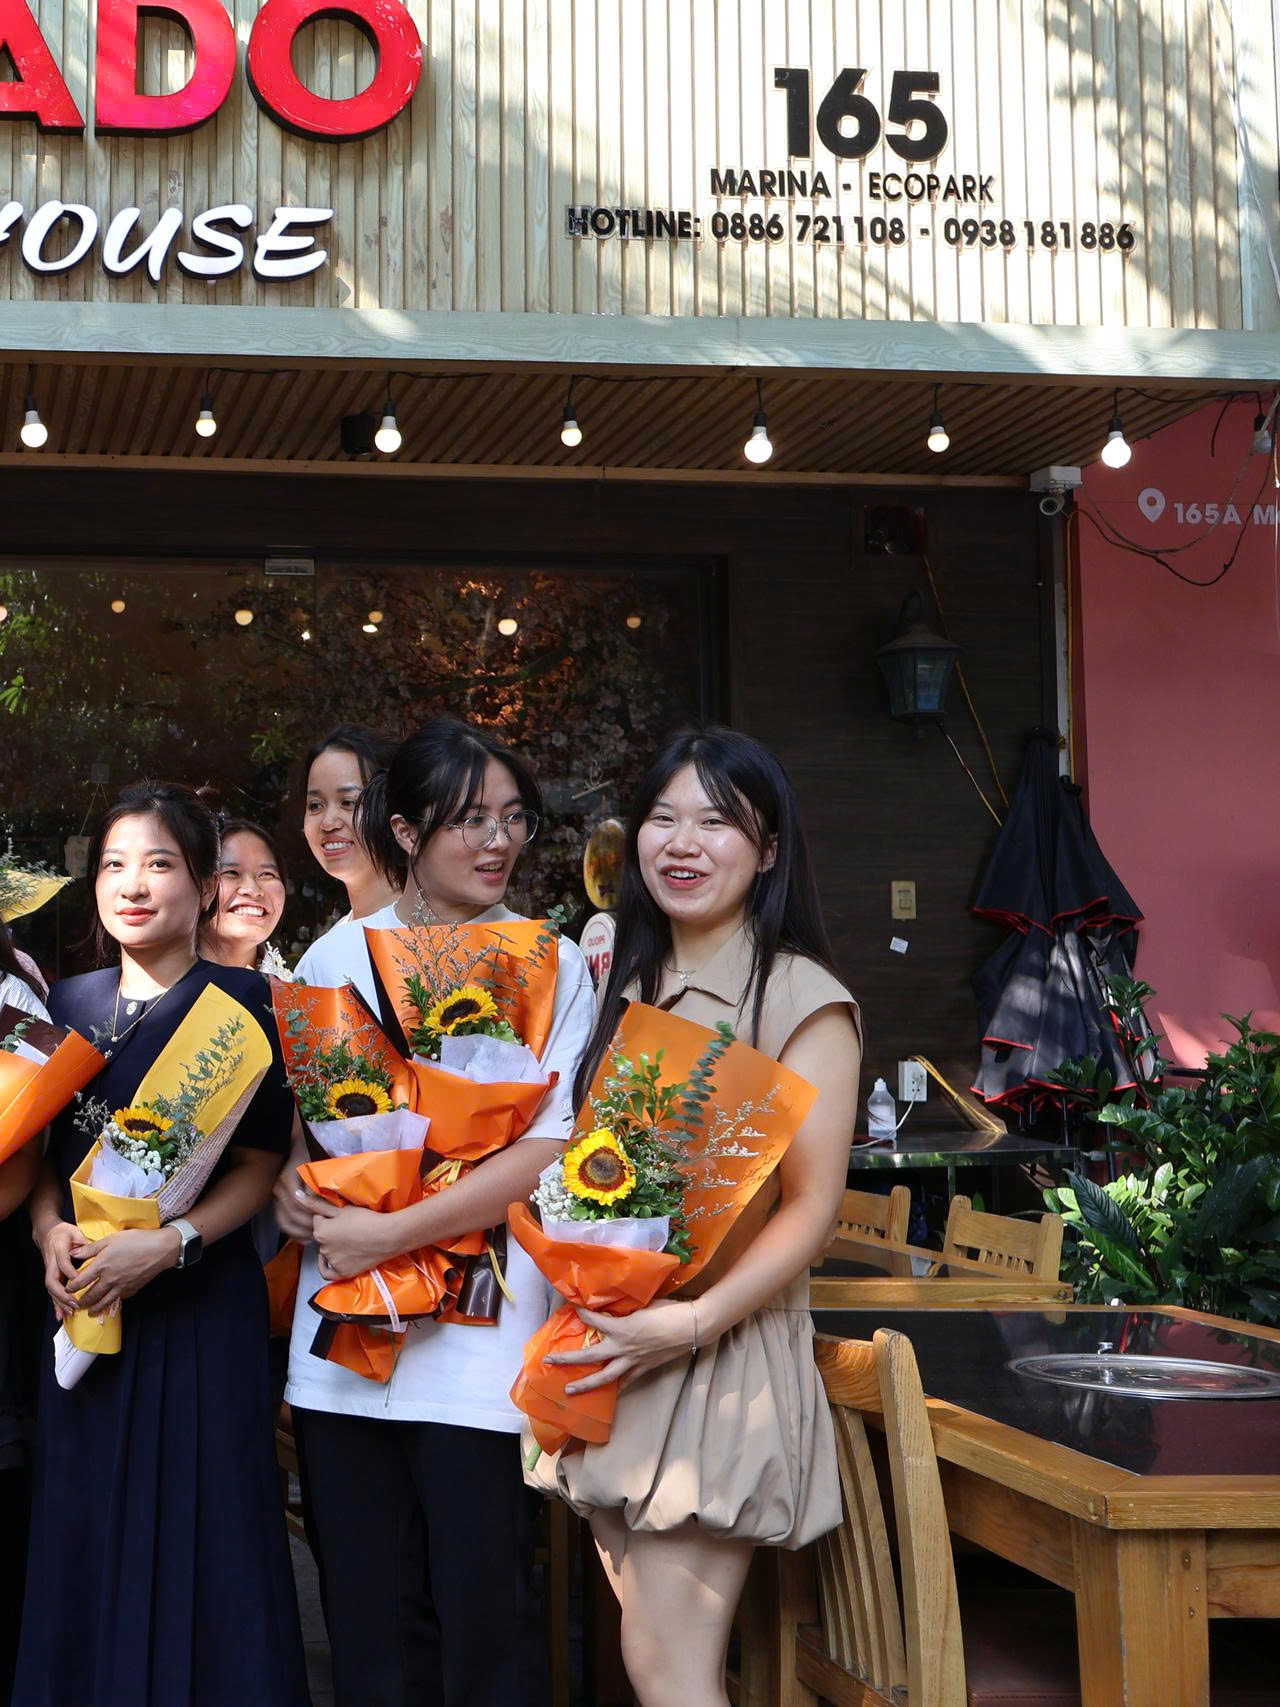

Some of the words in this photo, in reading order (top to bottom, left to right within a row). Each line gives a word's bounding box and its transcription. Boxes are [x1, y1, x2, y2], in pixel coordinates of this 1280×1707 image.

[774, 67, 948, 163] 165
[709, 168, 832, 198] MARINA
[869, 172, 995, 203] ECOPARK
[568, 207, 701, 239] HOTLINE:
[711, 212, 784, 241] 0886
[944, 217, 1016, 246] 0938
[1174, 503, 1241, 525] 165A
[1253, 504, 1280, 525] M
